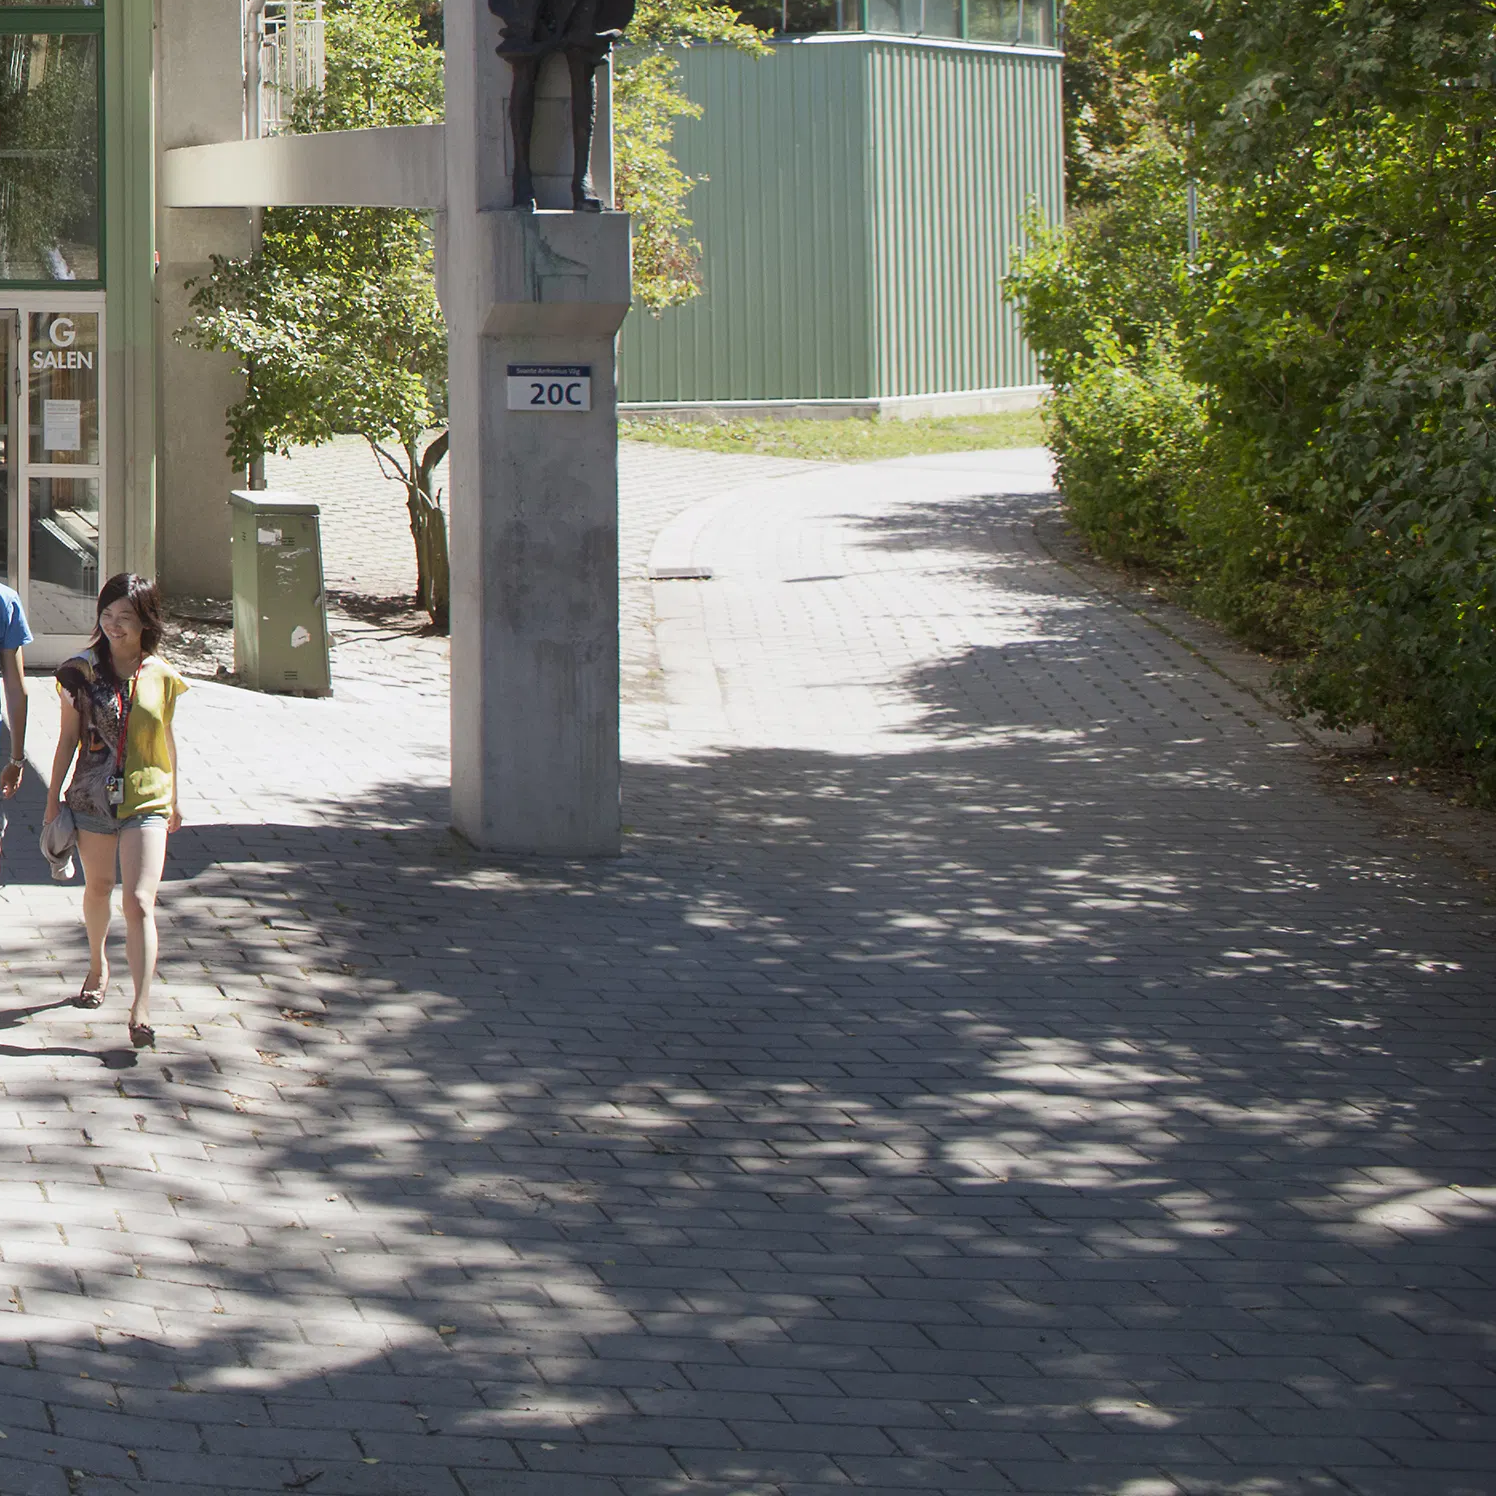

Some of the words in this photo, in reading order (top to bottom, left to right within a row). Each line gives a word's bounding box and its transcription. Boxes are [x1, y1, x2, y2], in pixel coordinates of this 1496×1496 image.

[49, 317, 76, 347] G
[32, 350, 93, 370] SALEN
[530, 383, 582, 405] 20C
